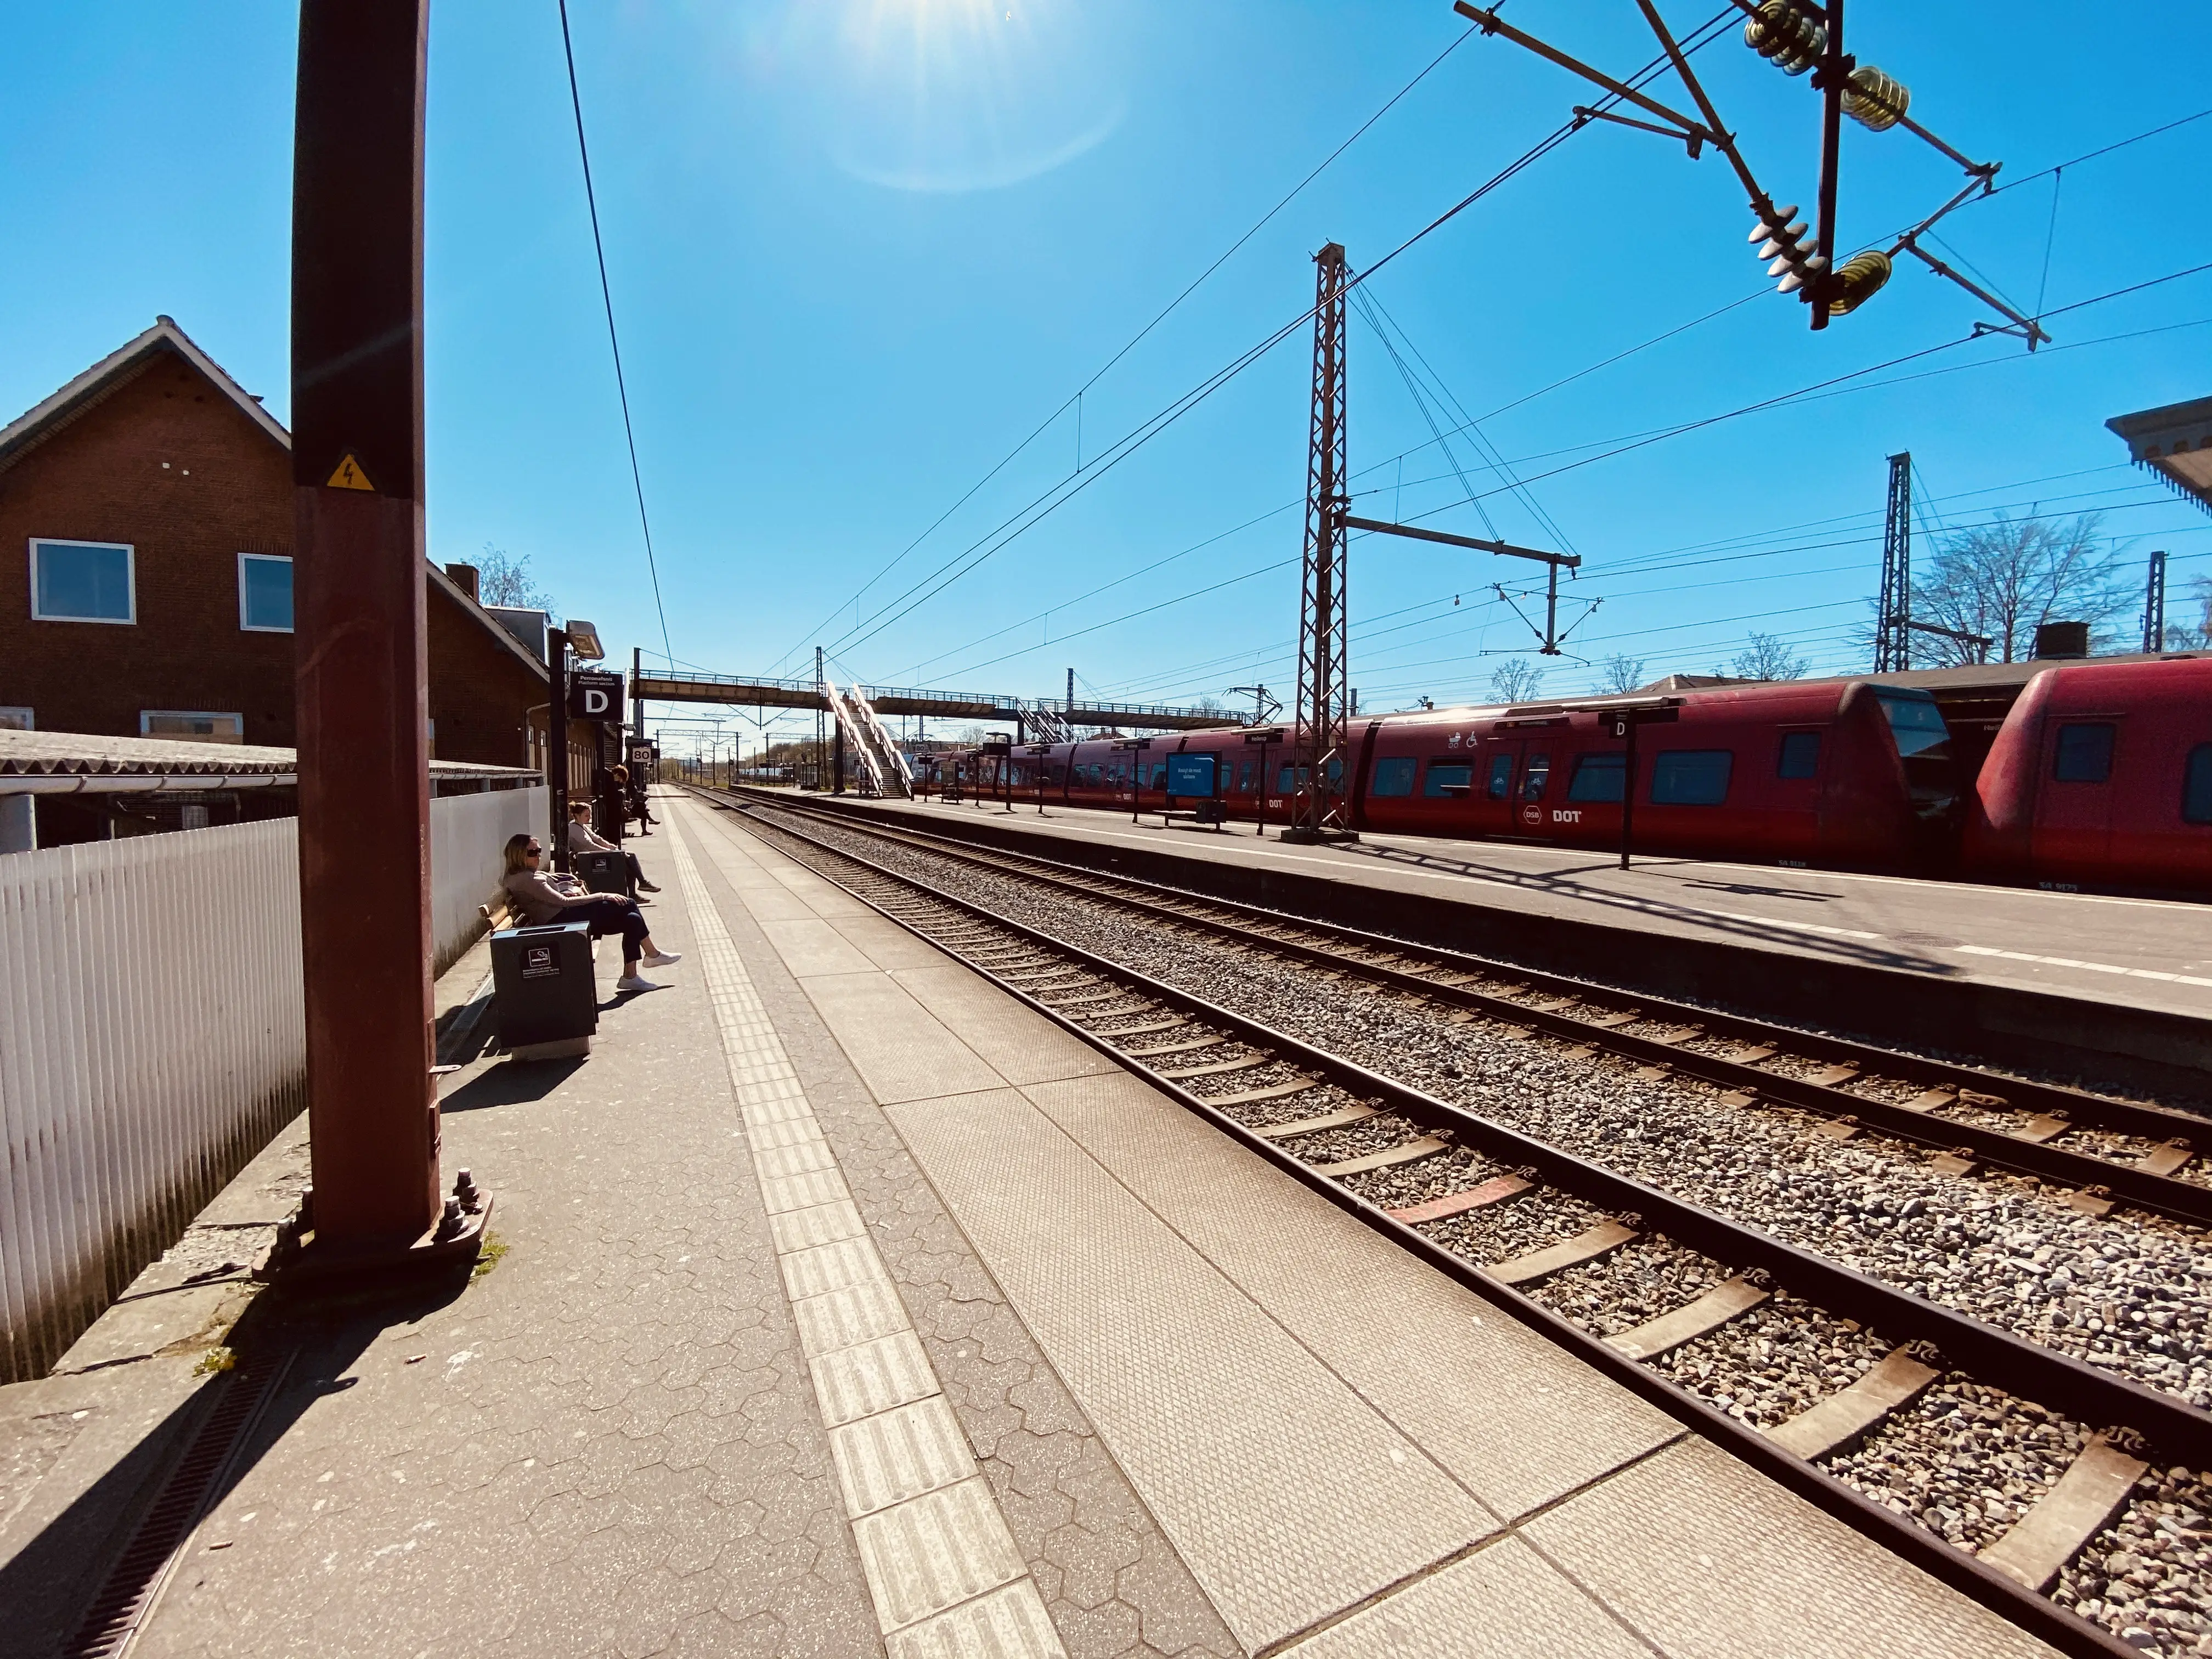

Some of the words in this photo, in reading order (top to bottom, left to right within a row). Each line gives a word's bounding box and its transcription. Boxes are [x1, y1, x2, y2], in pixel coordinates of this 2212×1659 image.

[585, 690, 608, 713] D
[1617, 722, 1625, 735] D
[634, 751, 650, 759] 80
[1269, 799, 1283, 808] DOT
[1553, 810, 1579, 822] DOT
